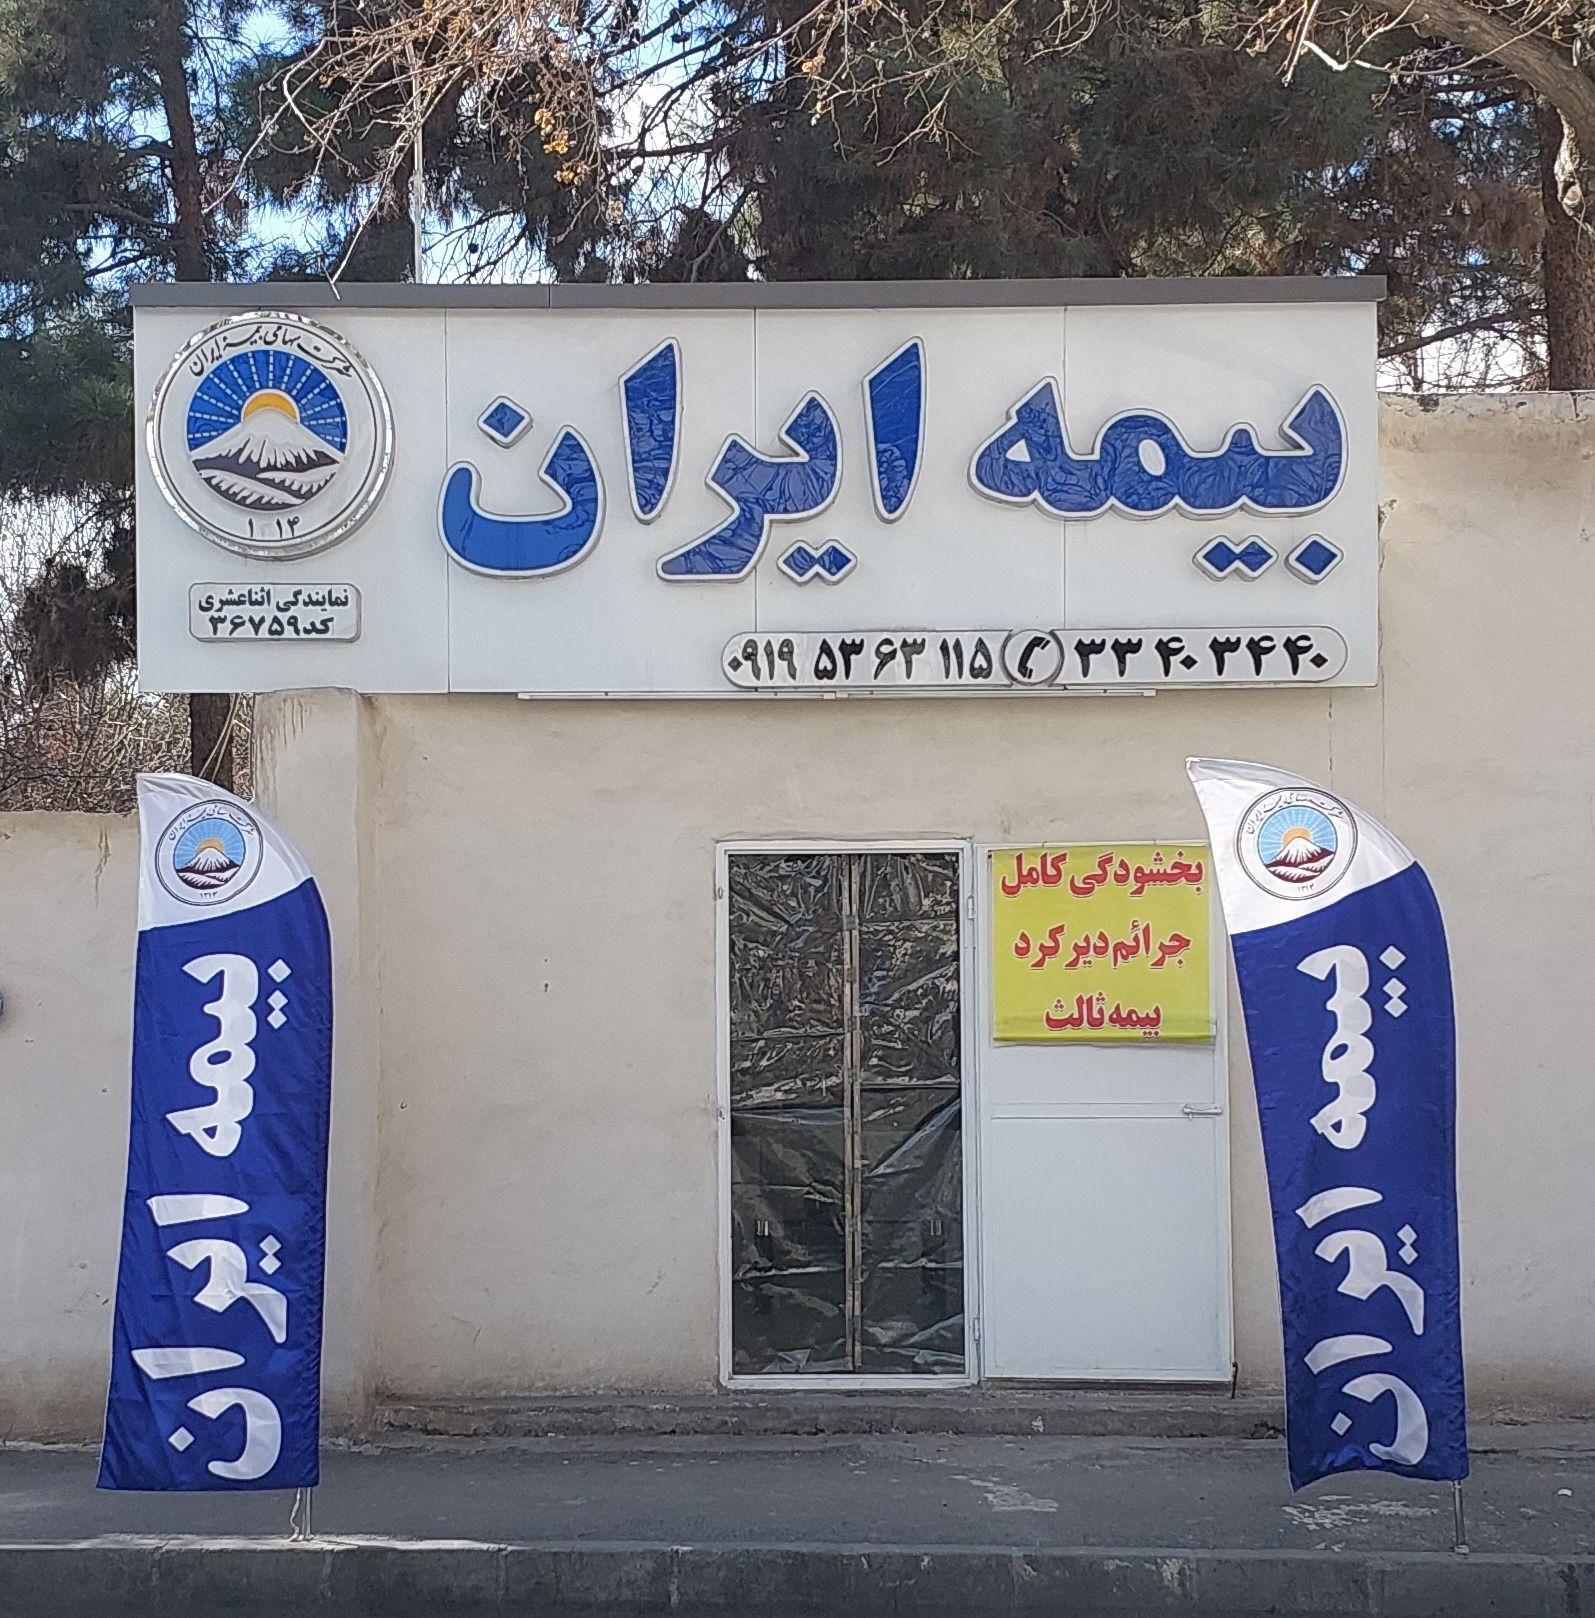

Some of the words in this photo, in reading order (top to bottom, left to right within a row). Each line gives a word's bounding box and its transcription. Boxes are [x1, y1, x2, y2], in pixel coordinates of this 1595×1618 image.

[189, 338, 222, 377] ایران
[296, 344, 353, 378] شرکت
[439, 336, 926, 583] ایران
[969, 376, 1350, 584] بیمه
[275, 588, 349, 612] نمایندگی
[727, 637, 798, 681] ۰۹۱۹
[1001, 852, 1068, 897] کامل
[1069, 850, 1204, 897] بخشودگی
[1112, 919, 1192, 969] جرائم
[1045, 991, 1107, 1030] ثالث
[1108, 1002, 1163, 1038] بیمه
[166, 953, 292, 1157] بیمه
[1297, 944, 1407, 1150] بیمه
[131, 1193, 288, 1480] ایران
[1295, 1186, 1429, 1466] ایران
